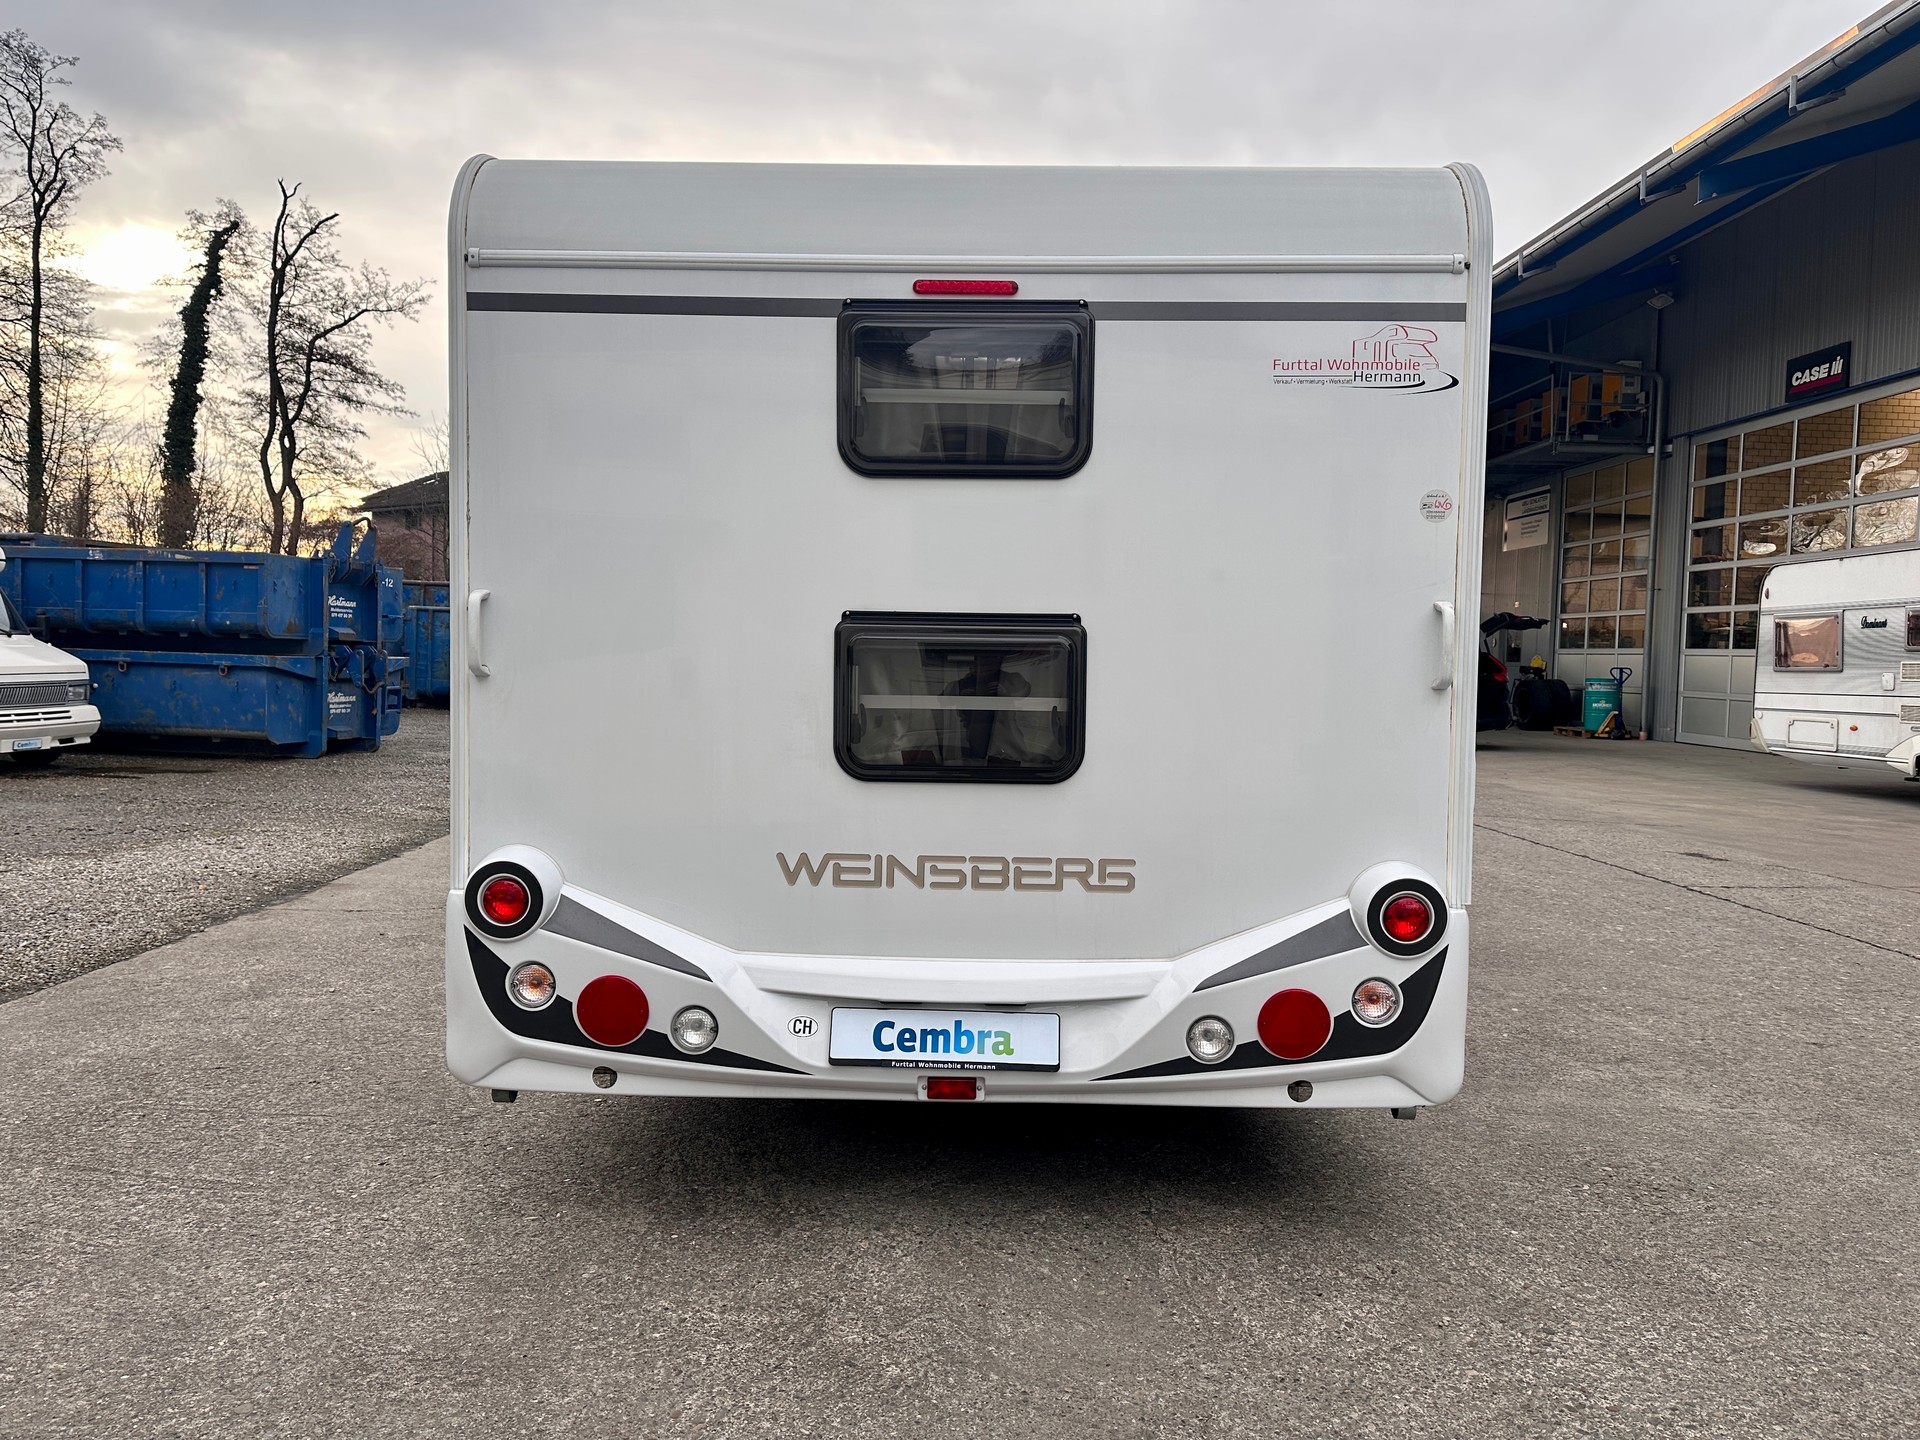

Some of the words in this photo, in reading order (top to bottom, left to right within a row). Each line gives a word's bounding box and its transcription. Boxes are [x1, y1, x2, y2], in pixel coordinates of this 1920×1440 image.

[1273, 359, 1322, 370] Furttal
[1327, 359, 1420, 370] Wohnmobile
[1353, 371, 1421, 382] Hermann
[1791, 363, 1830, 386] CASE
[328, 595, 357, 608] Hartmann
[776, 852, 1137, 893] WEINSBERG
[791, 1018, 813, 1035] CH
[872, 1019, 1015, 1056] Cembra
